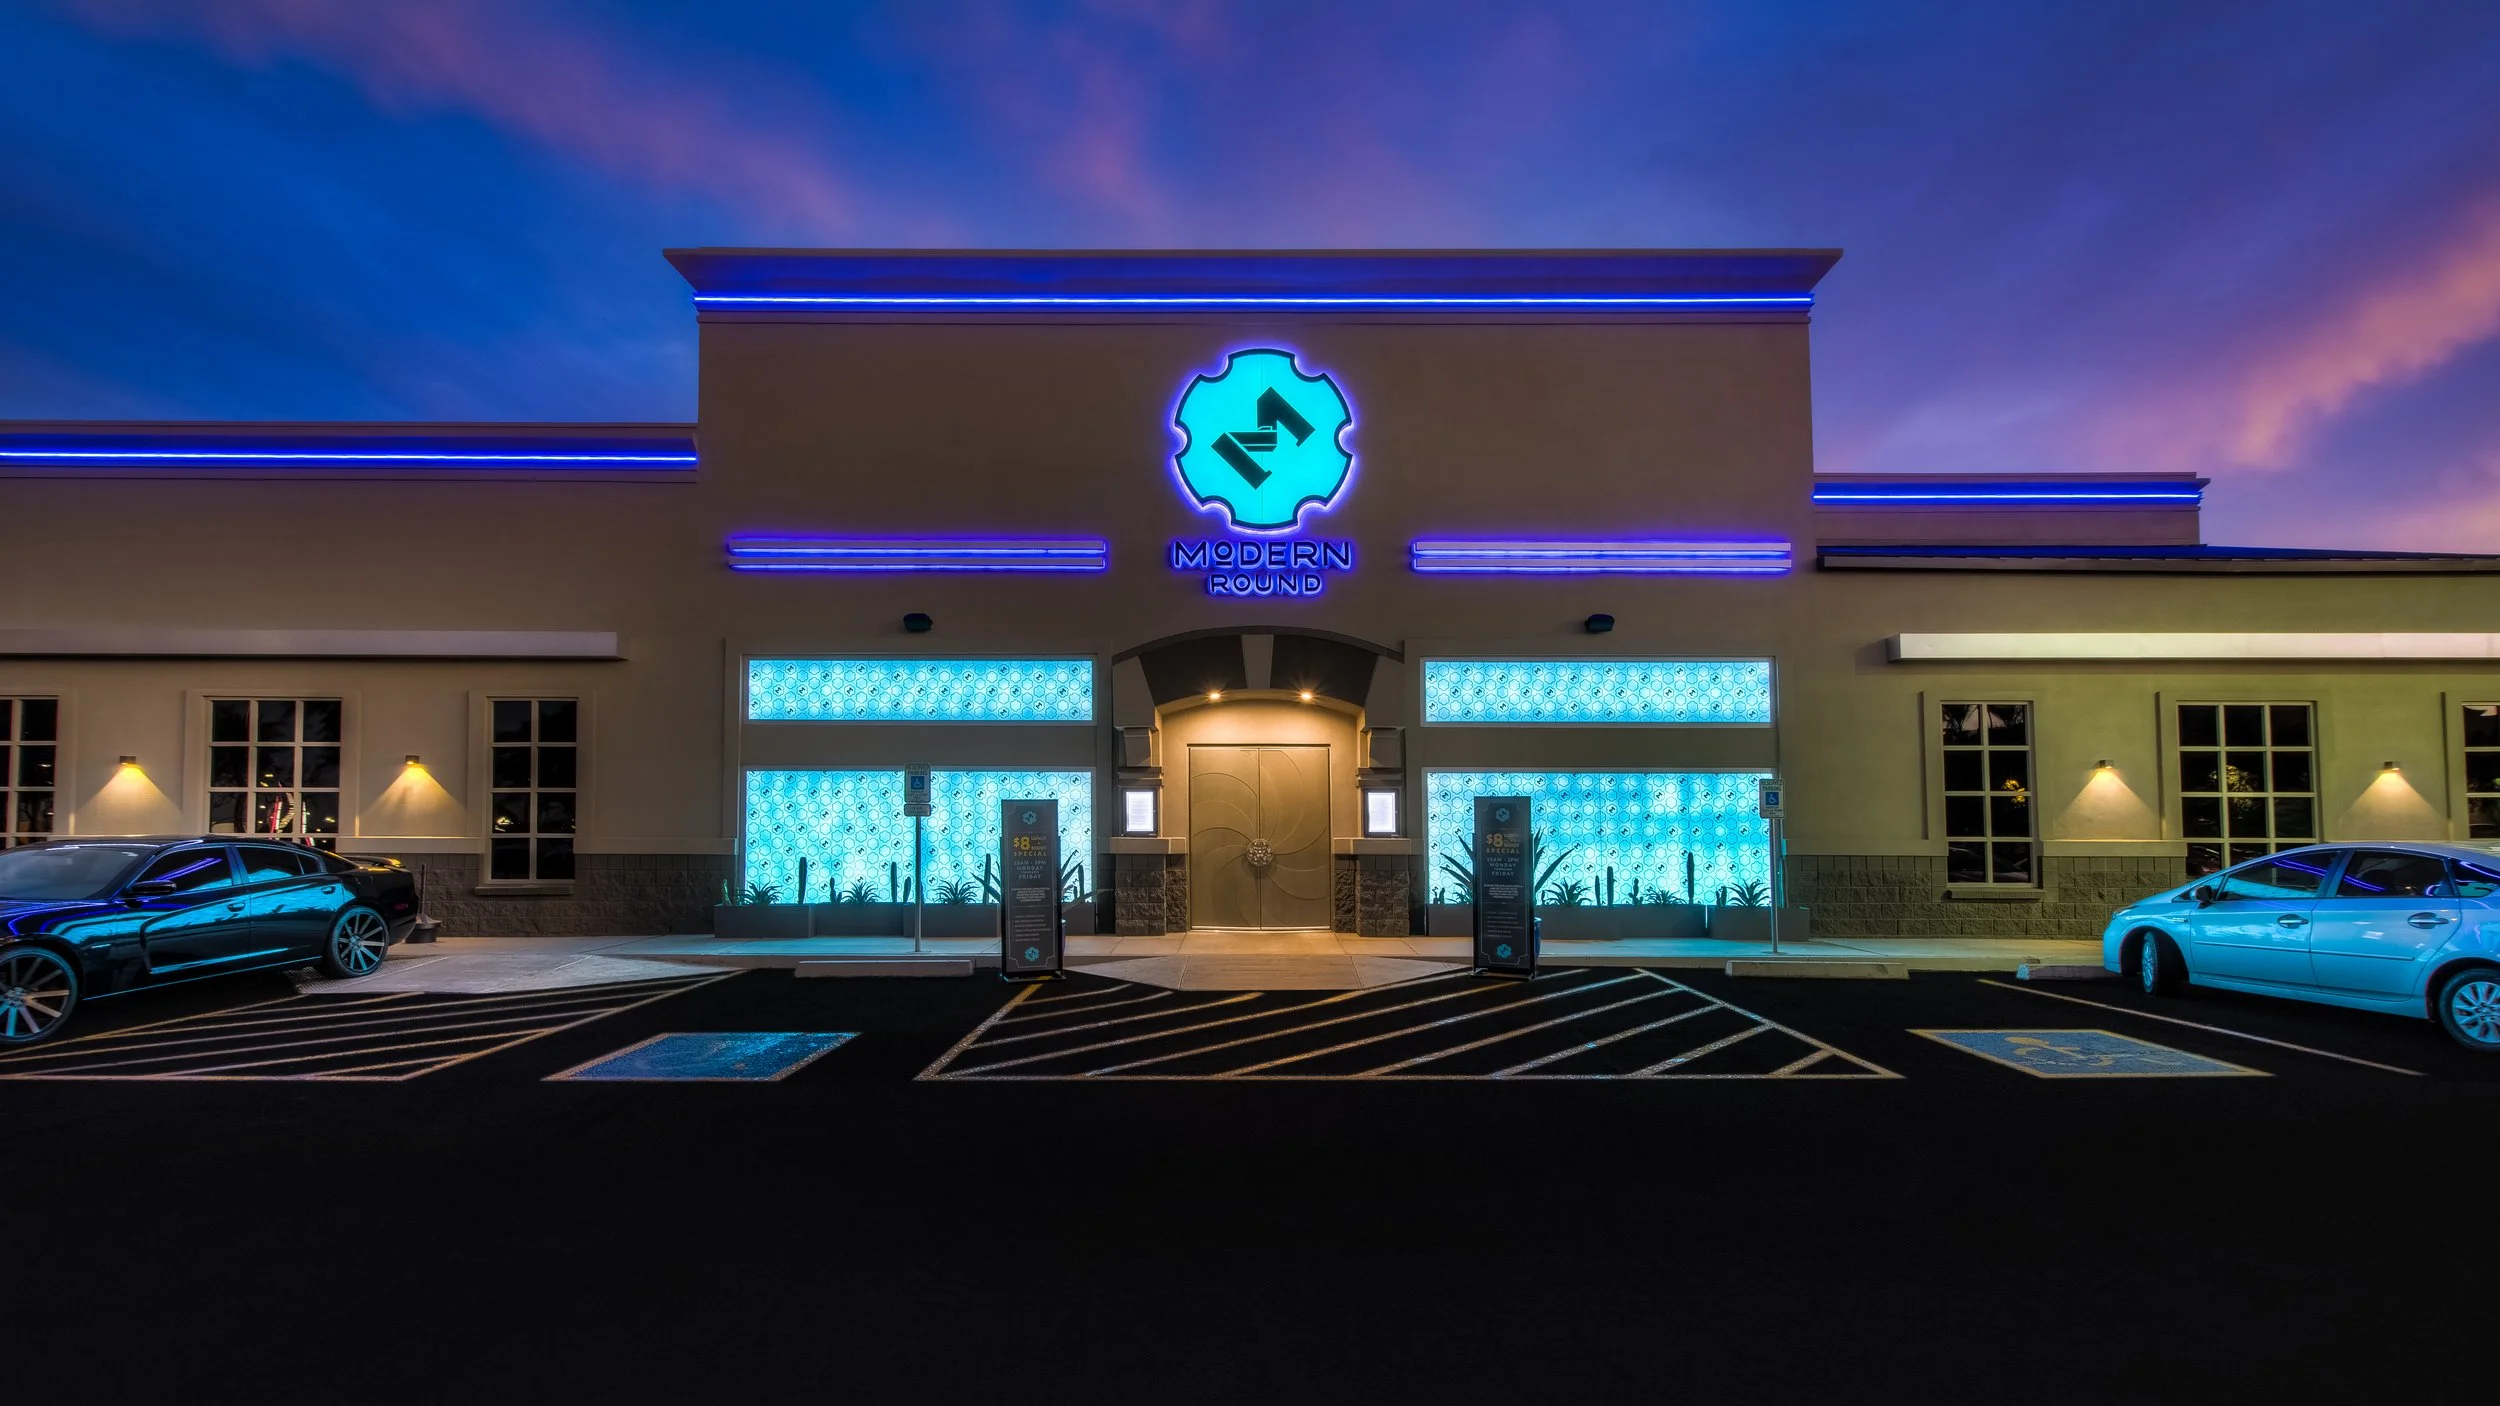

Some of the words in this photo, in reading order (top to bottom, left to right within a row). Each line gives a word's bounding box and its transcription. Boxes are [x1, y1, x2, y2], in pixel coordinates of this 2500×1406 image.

[1172, 540, 1351, 569] MODERN
[1209, 573, 1322, 594] ROUND
[1013, 836, 1031, 850] $8
[1486, 833, 1504, 848] $8
